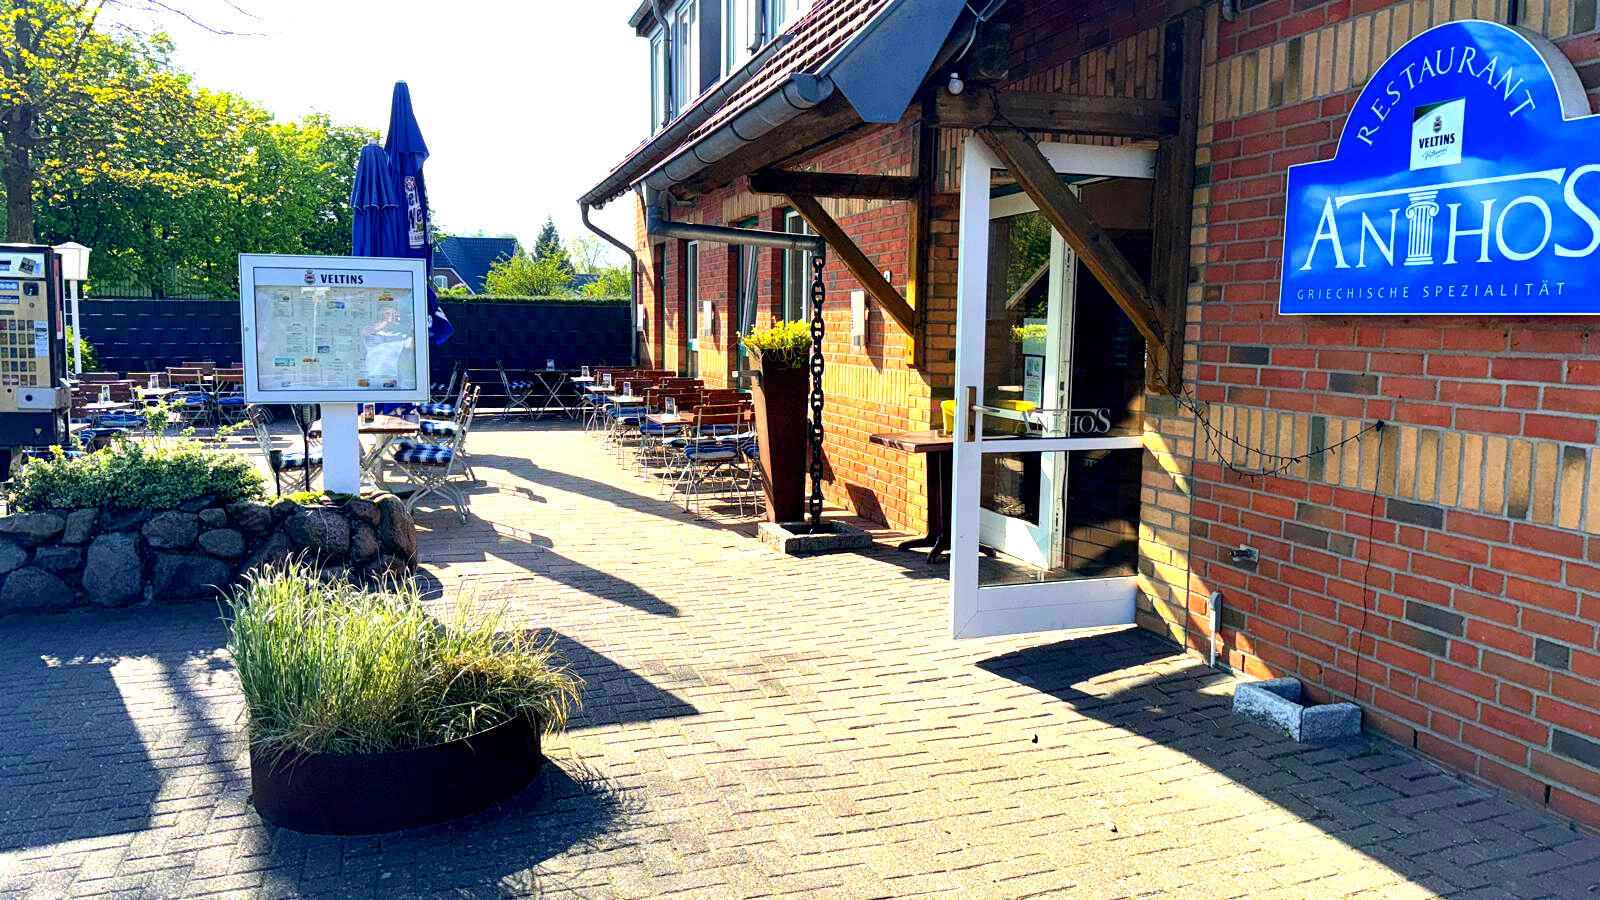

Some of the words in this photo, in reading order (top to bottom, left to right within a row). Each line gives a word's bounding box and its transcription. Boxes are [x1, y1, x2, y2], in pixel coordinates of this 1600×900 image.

[1357, 46, 1536, 146] RESTAURANT
[1419, 133, 1455, 149] VELTINS
[320, 274, 364, 284] VELTINS
[1297, 286, 1409, 300] GRIECHISCHE
[1423, 282, 1566, 298] SPEZIALITÄT
